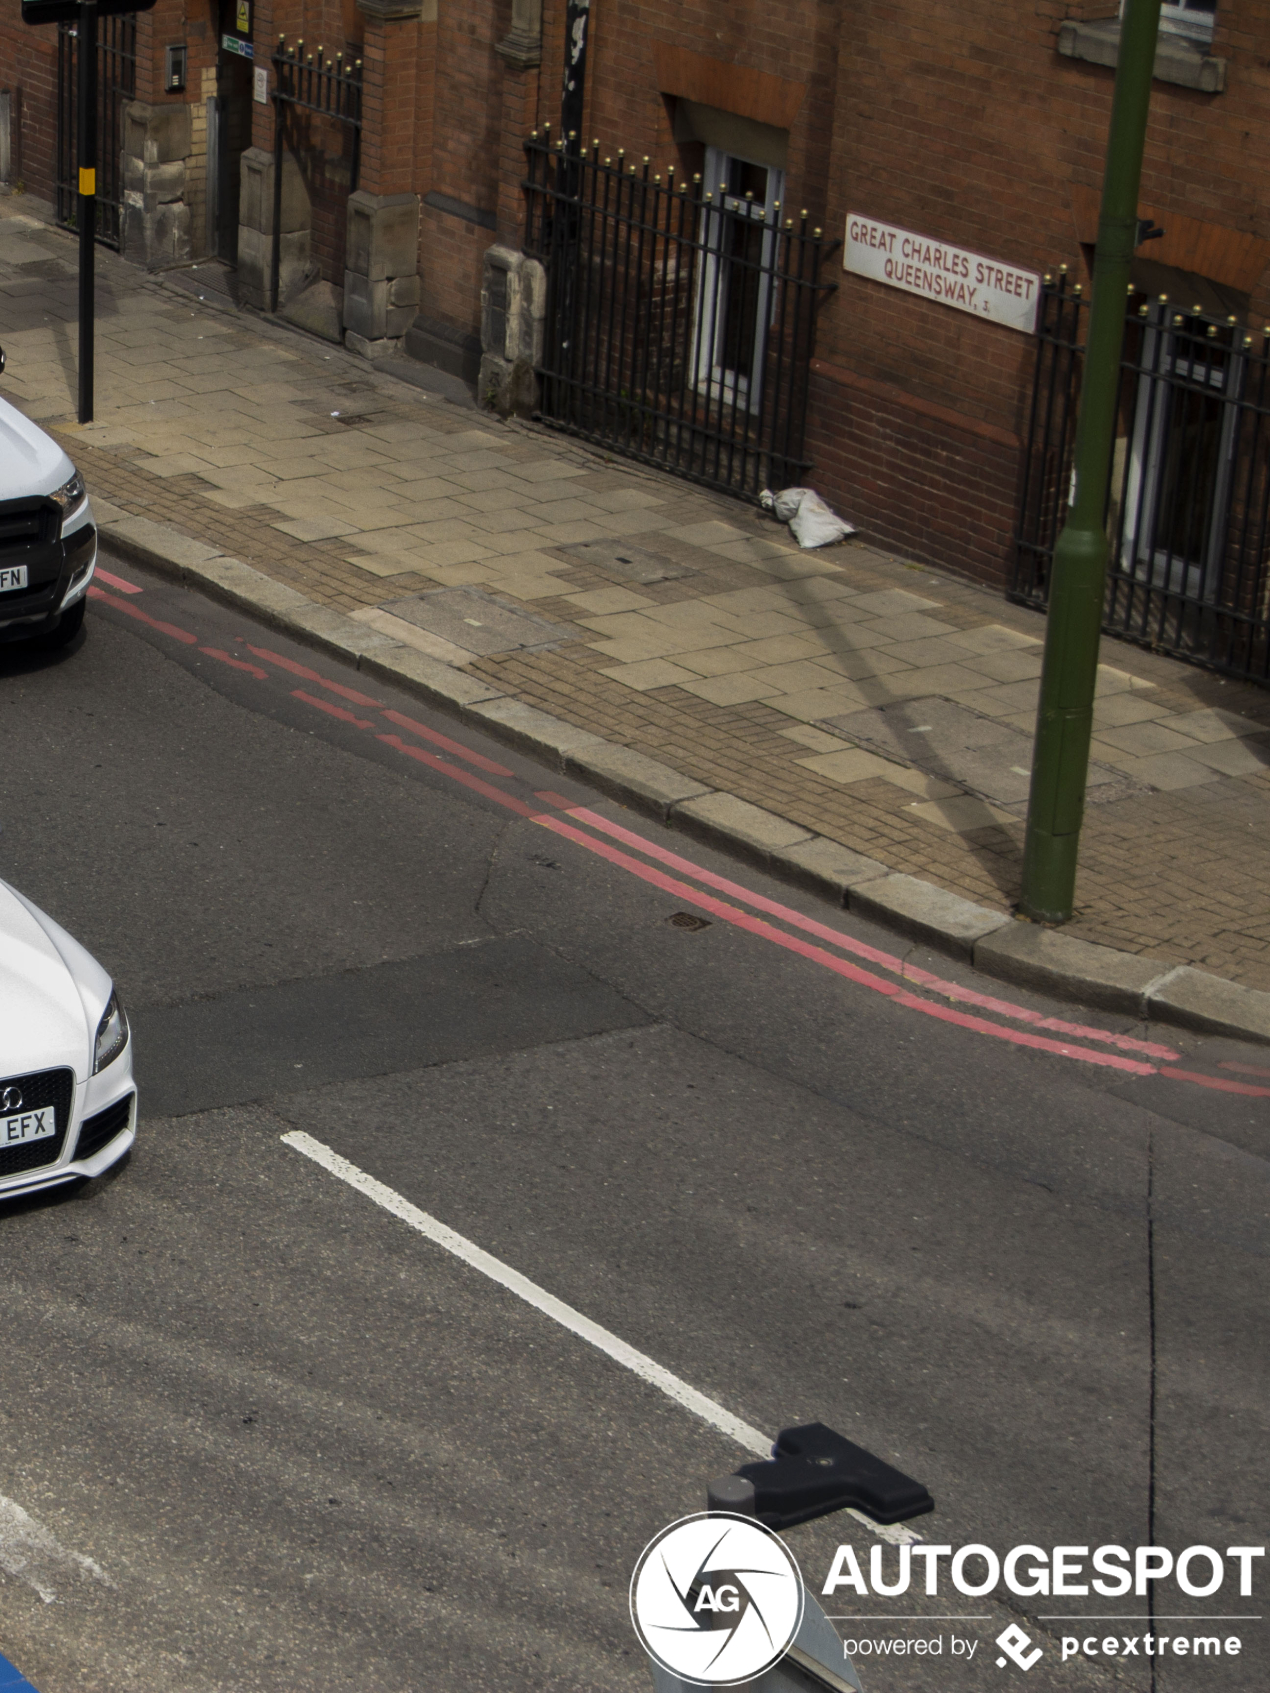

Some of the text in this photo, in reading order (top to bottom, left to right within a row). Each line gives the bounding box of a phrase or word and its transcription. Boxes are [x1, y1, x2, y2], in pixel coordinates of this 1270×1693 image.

[850, 221, 1033, 300] GREAT CHARLES STREET
[884, 258, 978, 310] QUEENSWAY,
[7, 1111, 46, 1140] EFX
